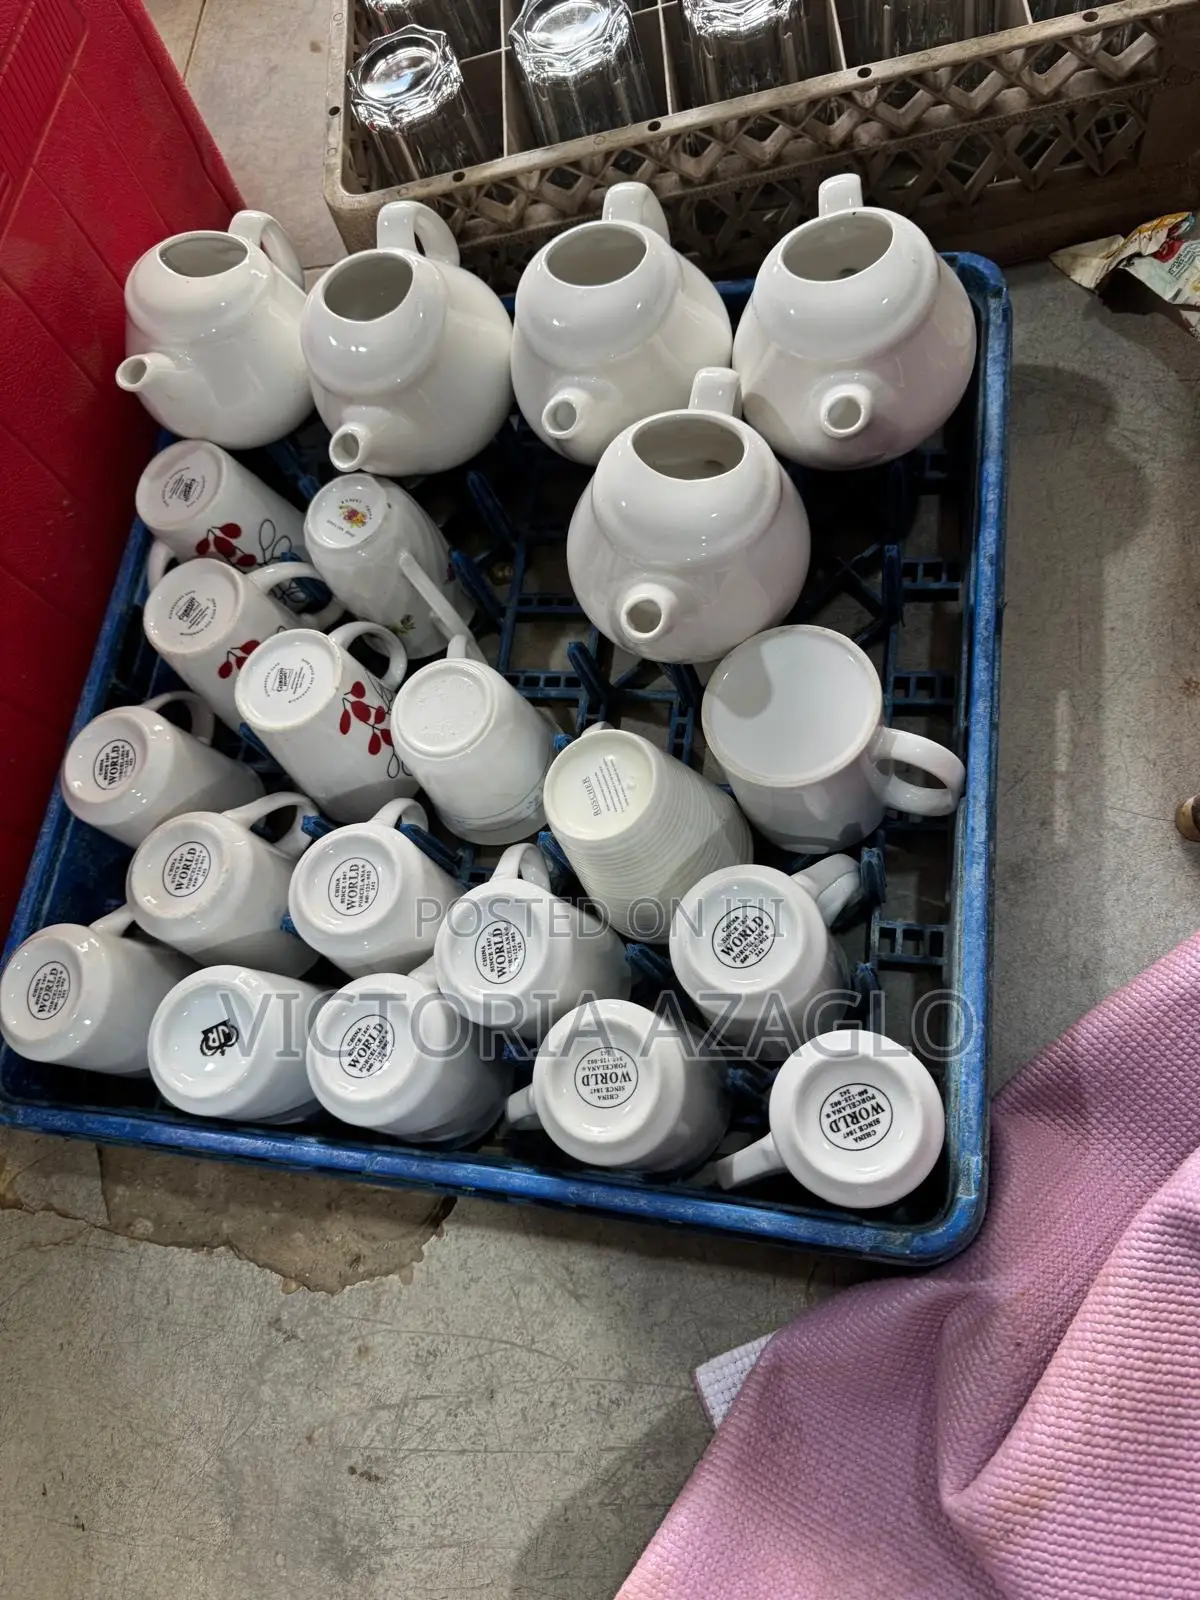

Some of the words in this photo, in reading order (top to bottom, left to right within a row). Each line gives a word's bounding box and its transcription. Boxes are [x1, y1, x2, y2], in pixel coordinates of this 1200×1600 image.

[108, 745, 120, 785] WORLD
[583, 775, 601, 816] ROSCHER
[174, 848, 197, 890] WORLD
[346, 864, 360, 910] WORLD
[721, 926, 739, 944] SINCE
[722, 915, 740, 933] CHINA
[721, 916, 764, 956] WORLD
[732, 929, 766, 963] PORCELANA
[487, 951, 496, 973] SINCE
[492, 928, 508, 978] WORLD
[37, 968, 58, 1013] WORLD
[347, 1027, 362, 1047] CHINA
[347, 1023, 384, 1068] WORLD
[587, 1061, 627, 1072] PORCELANA
[581, 1070, 632, 1087] WORLD
[605, 1085, 626, 1093] SINCE
[590, 1087, 604, 1095] 1847
[597, 1093, 619, 1101] CHINA
[831, 1093, 877, 1116] PORCELANA
[829, 1101, 886, 1133] WORLD
[857, 1117, 881, 1132] SINCE
[843, 1128, 858, 1139] 1847
[853, 1129, 877, 1143] CHINA
